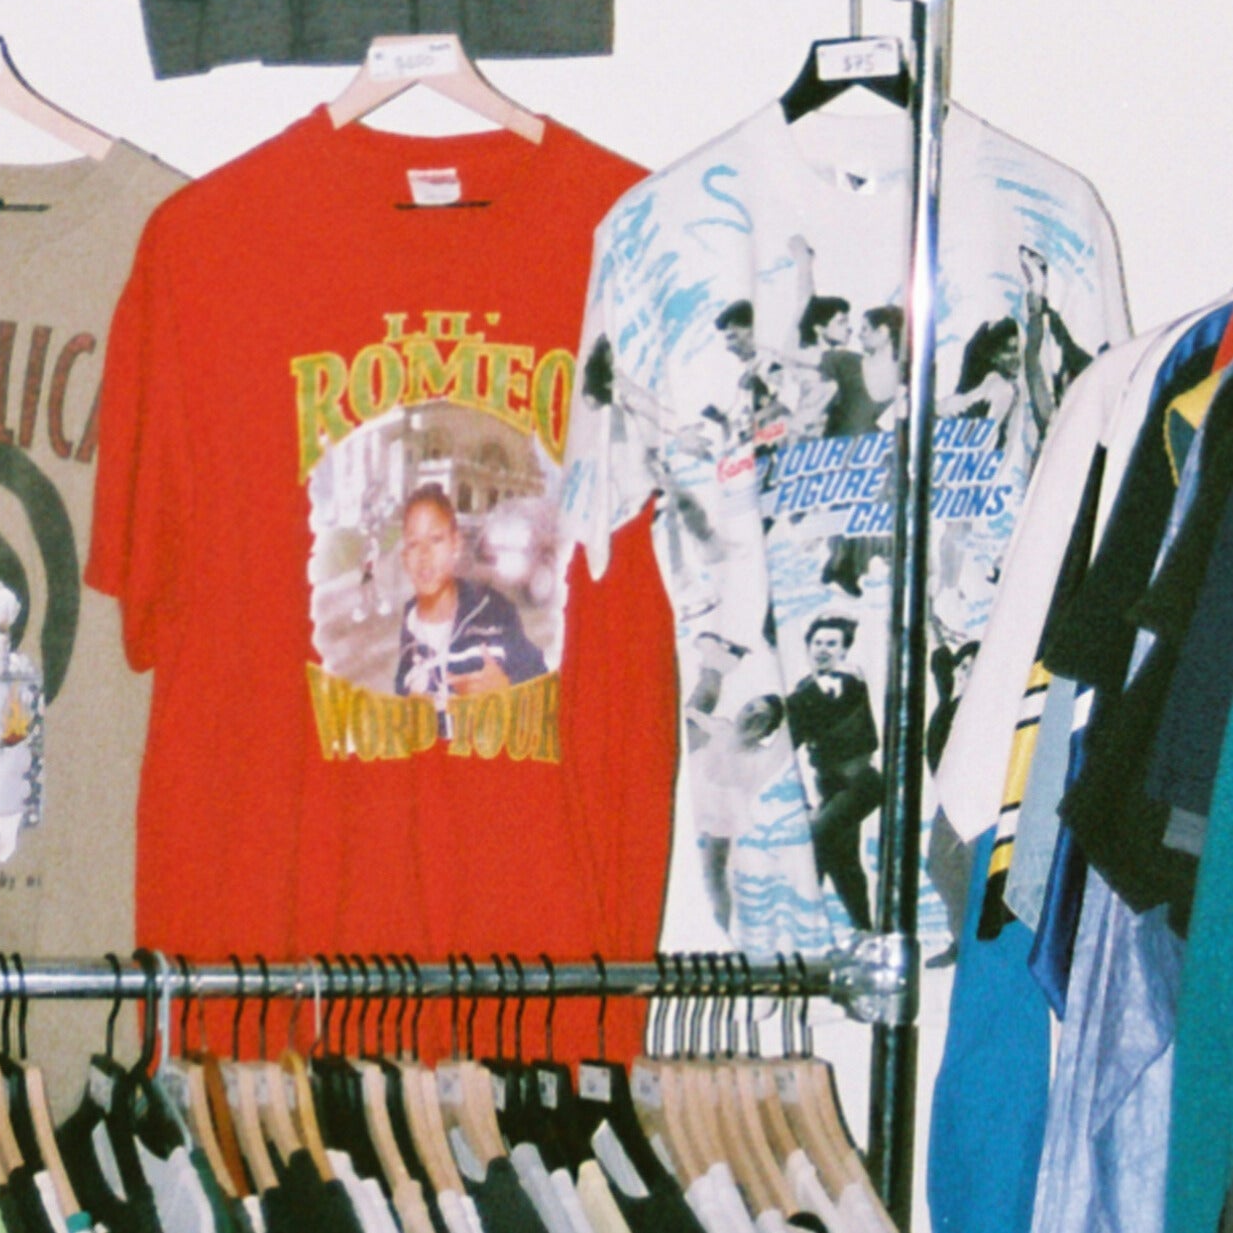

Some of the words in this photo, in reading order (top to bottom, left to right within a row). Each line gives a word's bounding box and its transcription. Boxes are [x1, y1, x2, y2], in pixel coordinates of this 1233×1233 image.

[289, 338, 578, 486] ROMEO
[850, 430, 896, 467] OF
[772, 466, 889, 516] FIGURE
